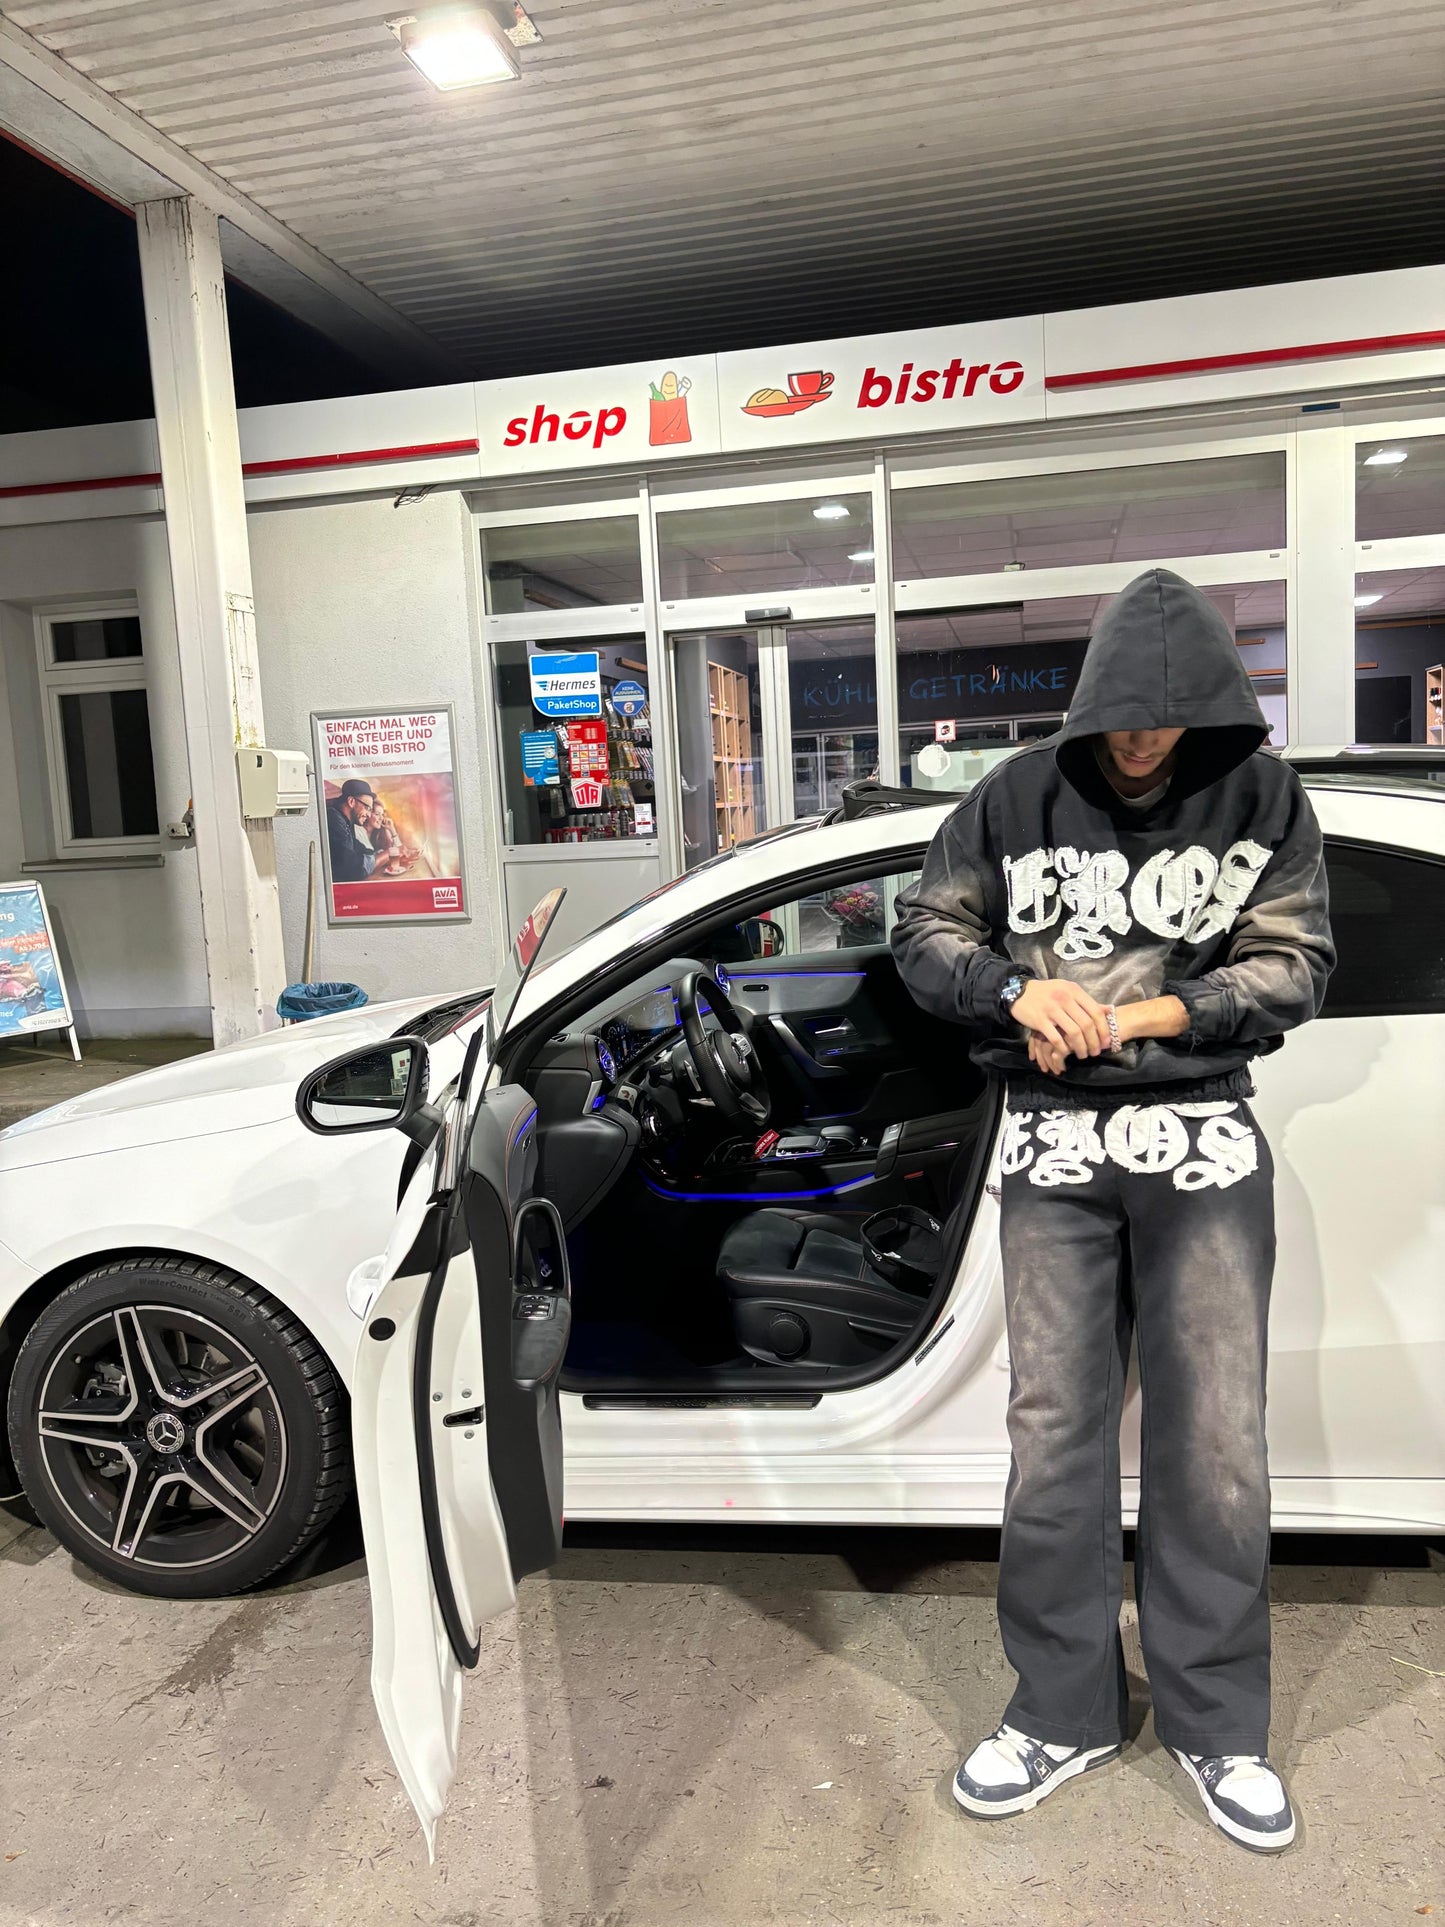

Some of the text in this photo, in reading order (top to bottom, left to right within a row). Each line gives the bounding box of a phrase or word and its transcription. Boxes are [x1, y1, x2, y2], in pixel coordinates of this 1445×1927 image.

[857, 358, 1025, 408] bistro
[503, 404, 627, 449] shop
[550, 679, 596, 691] Hermes
[909, 664, 1068, 700] GETRÄNKE
[547, 699, 597, 710] PaketShop
[326, 715, 436, 733] EINFACH MAL WEG
[327, 728, 433, 745] VOM STEUER UND
[328, 741, 426, 758] REIN INS BISTRO
[351, 761, 371, 769] kleinen
[371, 759, 414, 768] Genussmoment
[575, 782, 599, 805] UTA
[434, 888, 456, 898] AVIA
[1002, 838, 1274, 962] EROS
[0, 912, 15, 922] ng
[138, 1277, 208, 1298] WinterContact
